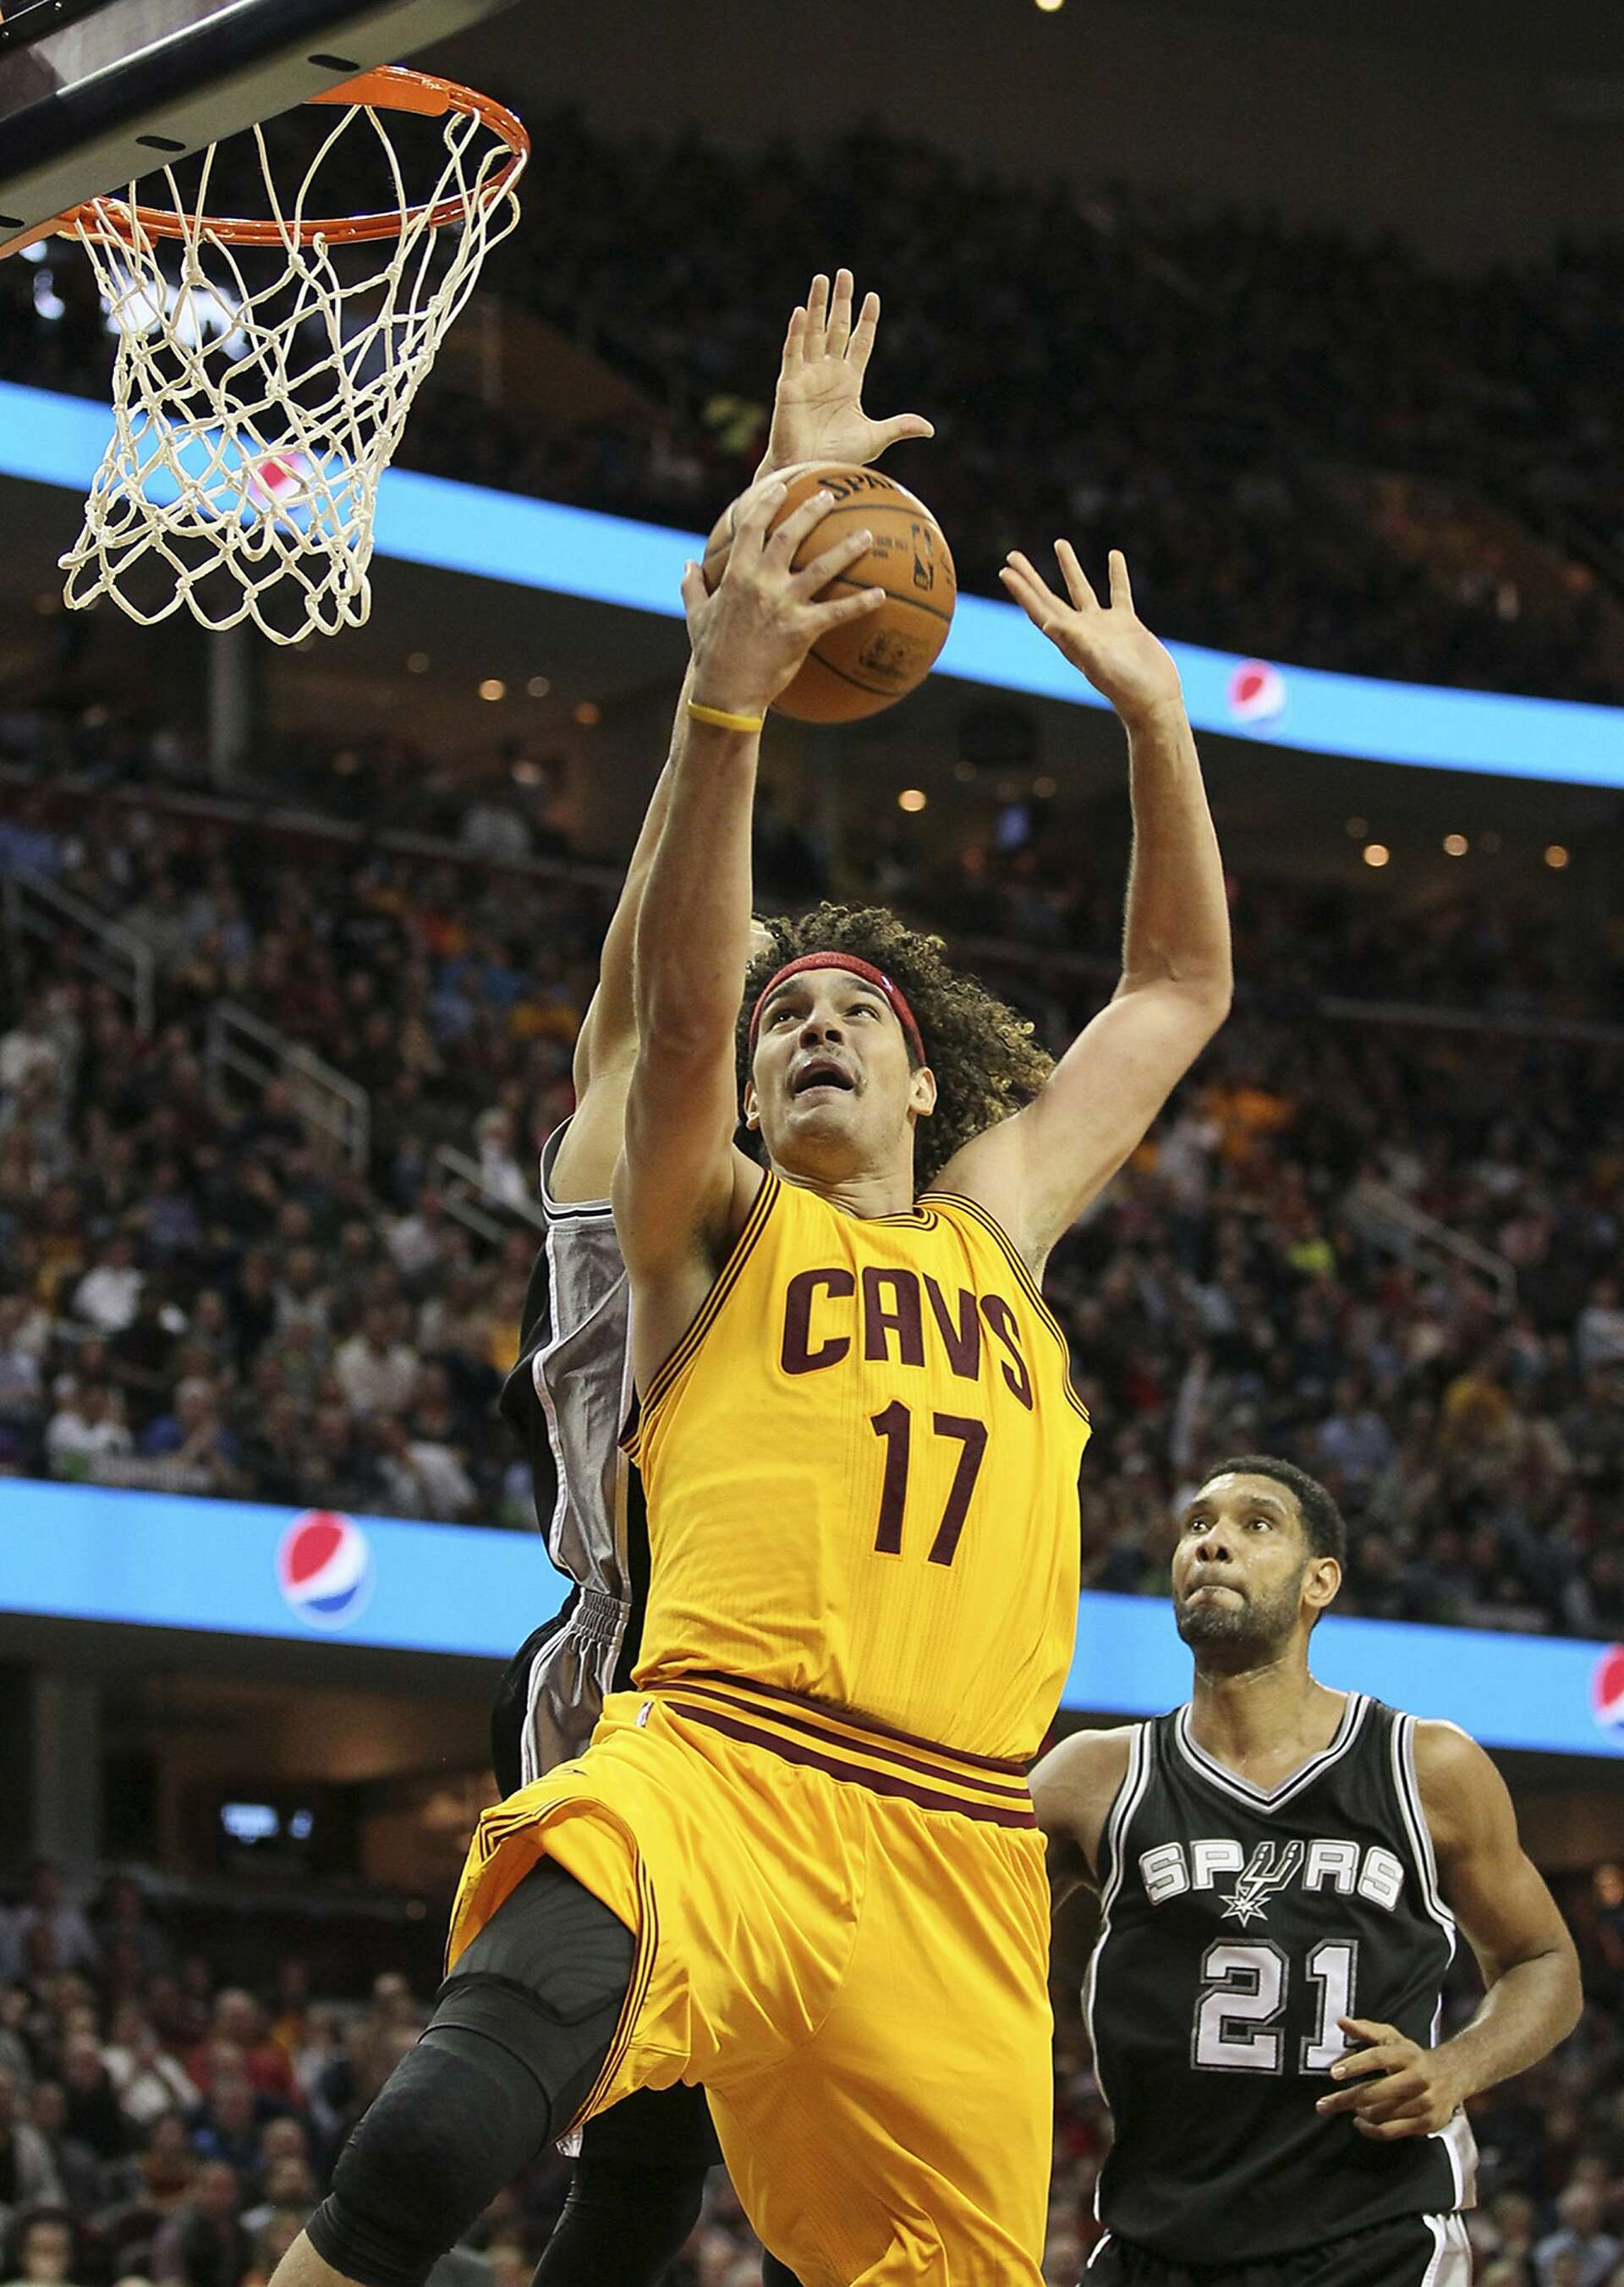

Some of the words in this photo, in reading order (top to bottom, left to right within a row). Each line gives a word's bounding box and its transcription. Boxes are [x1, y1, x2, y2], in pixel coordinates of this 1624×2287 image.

[781, 1266, 1033, 1411] CAVS
[870, 1400, 988, 1566] 17
[1138, 1839, 1405, 1928] SPURS
[1191, 1938, 1358, 2075] 21
